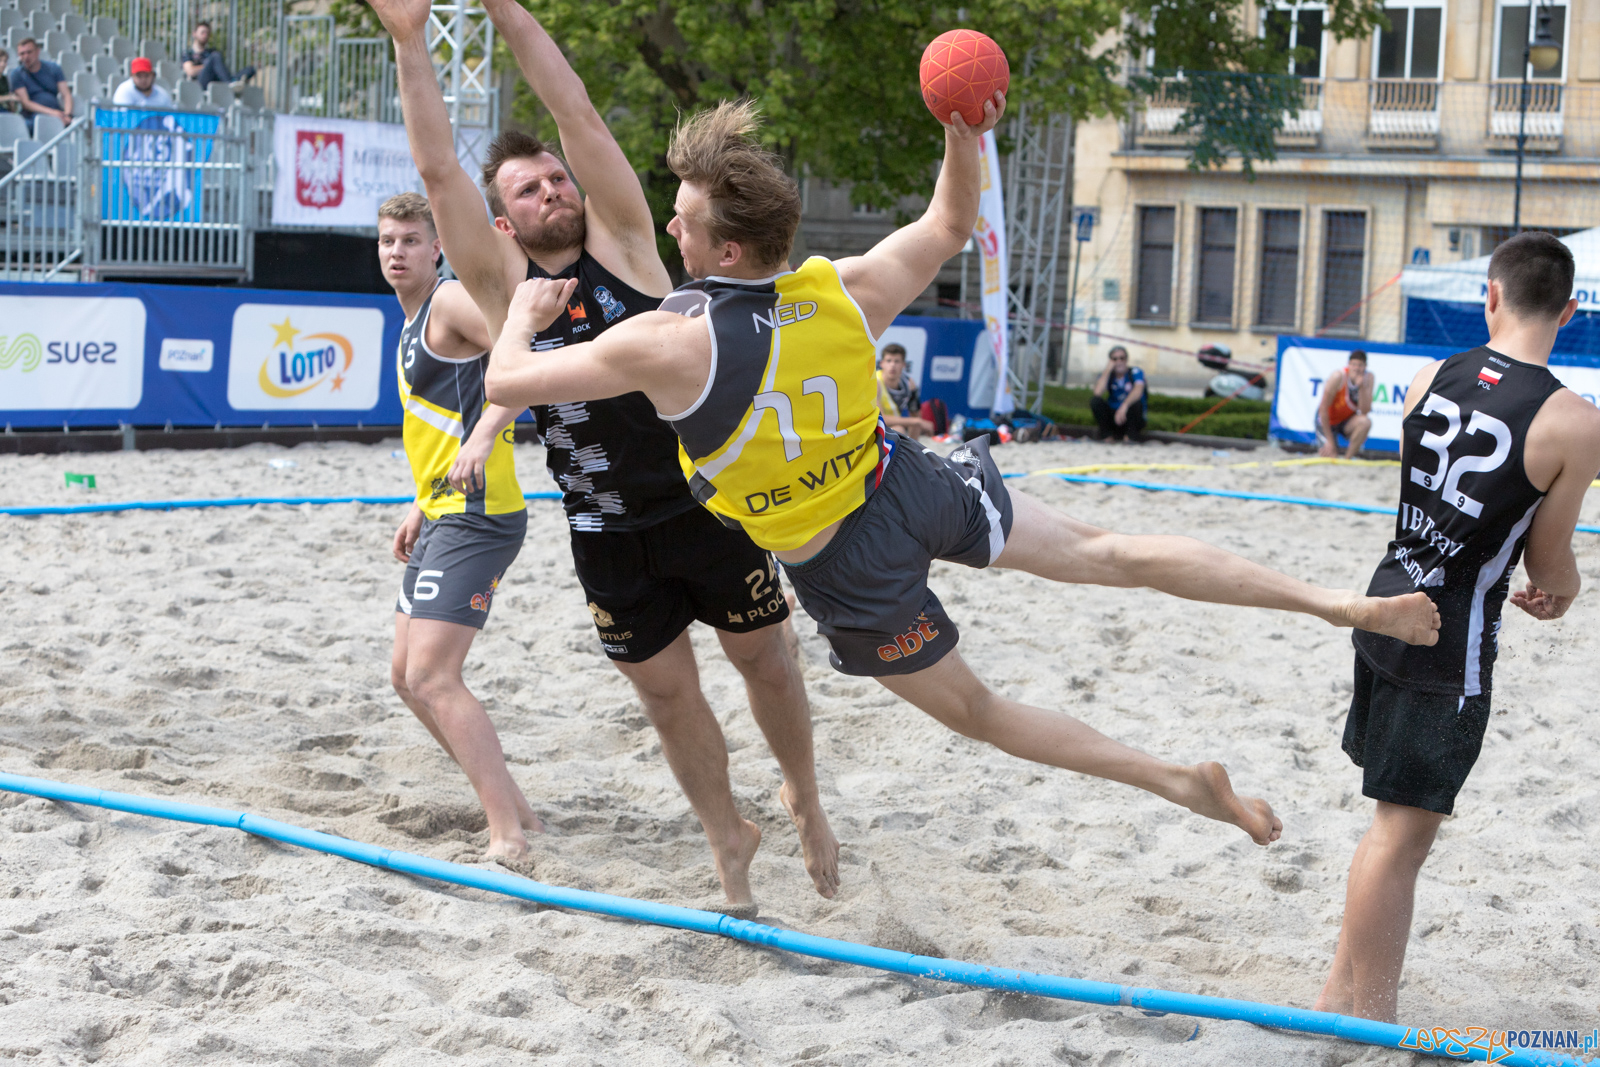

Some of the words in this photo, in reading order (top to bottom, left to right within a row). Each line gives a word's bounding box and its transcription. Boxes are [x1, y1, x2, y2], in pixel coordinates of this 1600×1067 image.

[752, 300, 818, 334] NED
[279, 345, 335, 384] LOTTO
[1477, 379, 1491, 391] POL
[1410, 391, 1513, 519] 32
[745, 485, 793, 514] DE
[413, 569, 444, 601] 6
[876, 621, 940, 662] ebt
